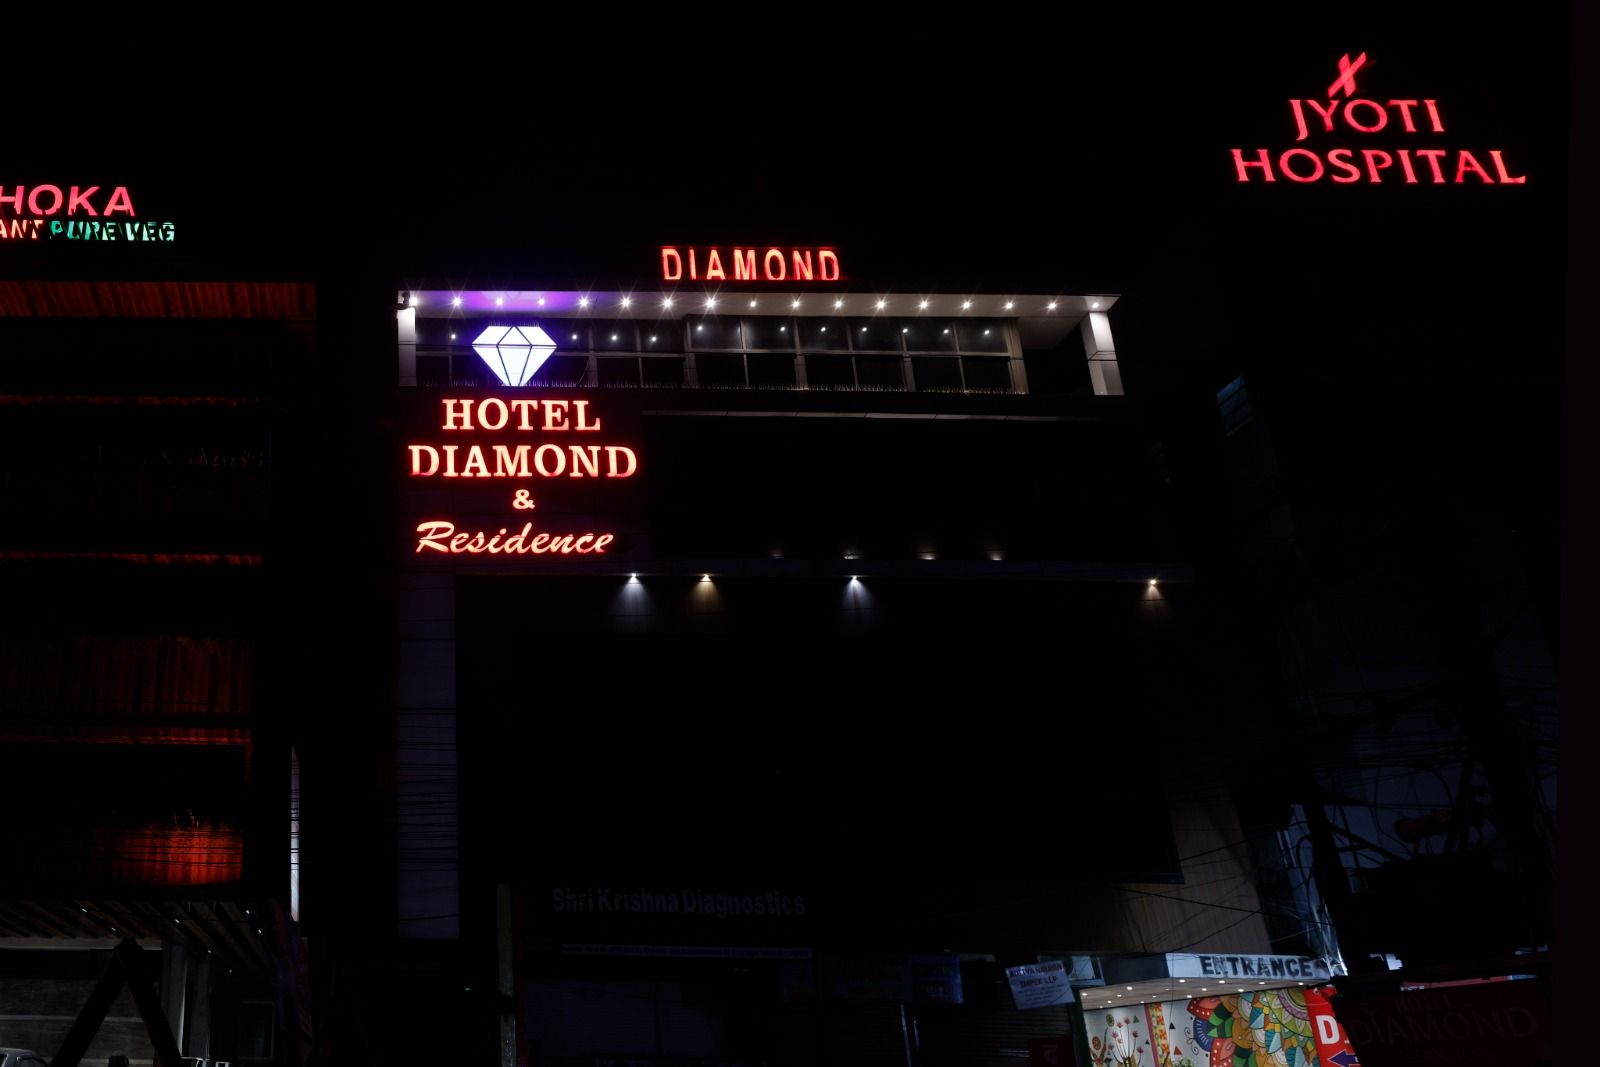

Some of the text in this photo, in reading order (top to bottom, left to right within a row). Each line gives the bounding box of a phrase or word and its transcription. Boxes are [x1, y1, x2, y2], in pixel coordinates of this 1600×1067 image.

[1289, 99, 1446, 141] JYOTI
[1230, 149, 1527, 184] HOSPITAL
[661, 247, 840, 281] DIAMOND
[442, 398, 601, 431] HOTEL
[408, 444, 637, 478] DIAMOND
[512, 489, 536, 510] &
[415, 520, 614, 554] Residence
[552, 885, 807, 920] Shri Krishna Diagnostics
[1200, 955, 1314, 977] ENTRANCE
